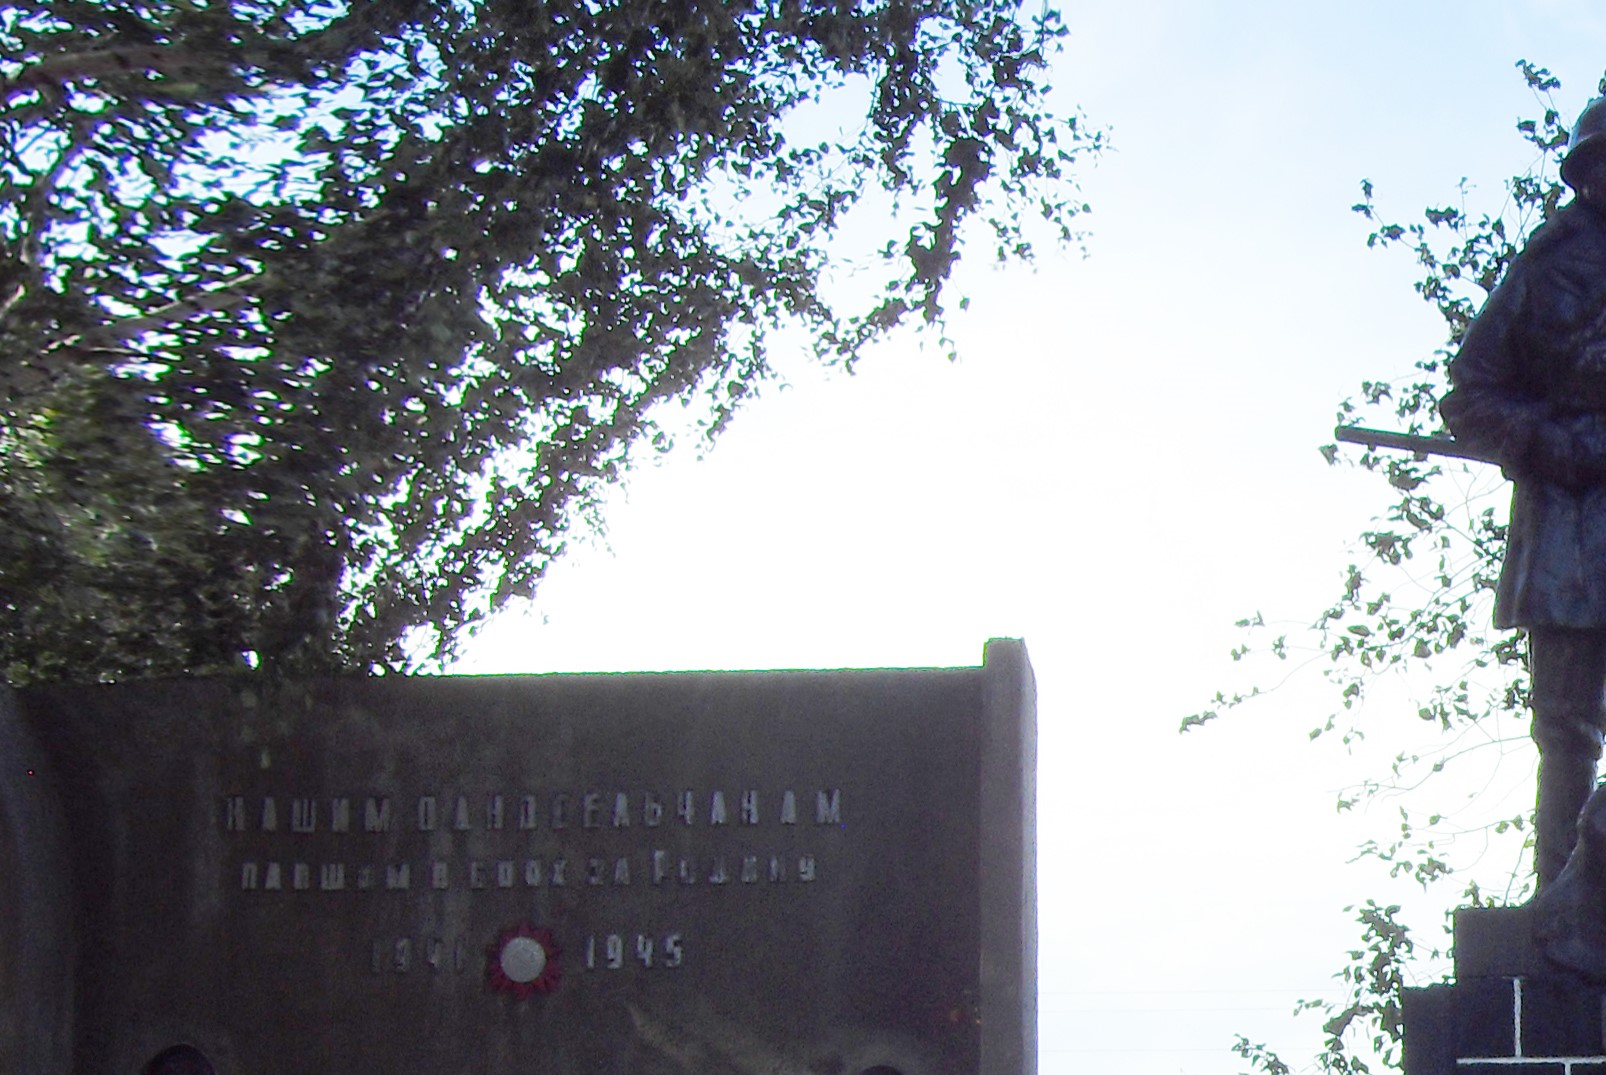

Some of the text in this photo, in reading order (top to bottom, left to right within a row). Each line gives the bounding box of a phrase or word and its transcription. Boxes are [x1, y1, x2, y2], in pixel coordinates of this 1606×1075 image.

[226, 796, 390, 833] НАШИМ
[432, 861, 449, 889] В
[586, 932, 683, 969] 1945
